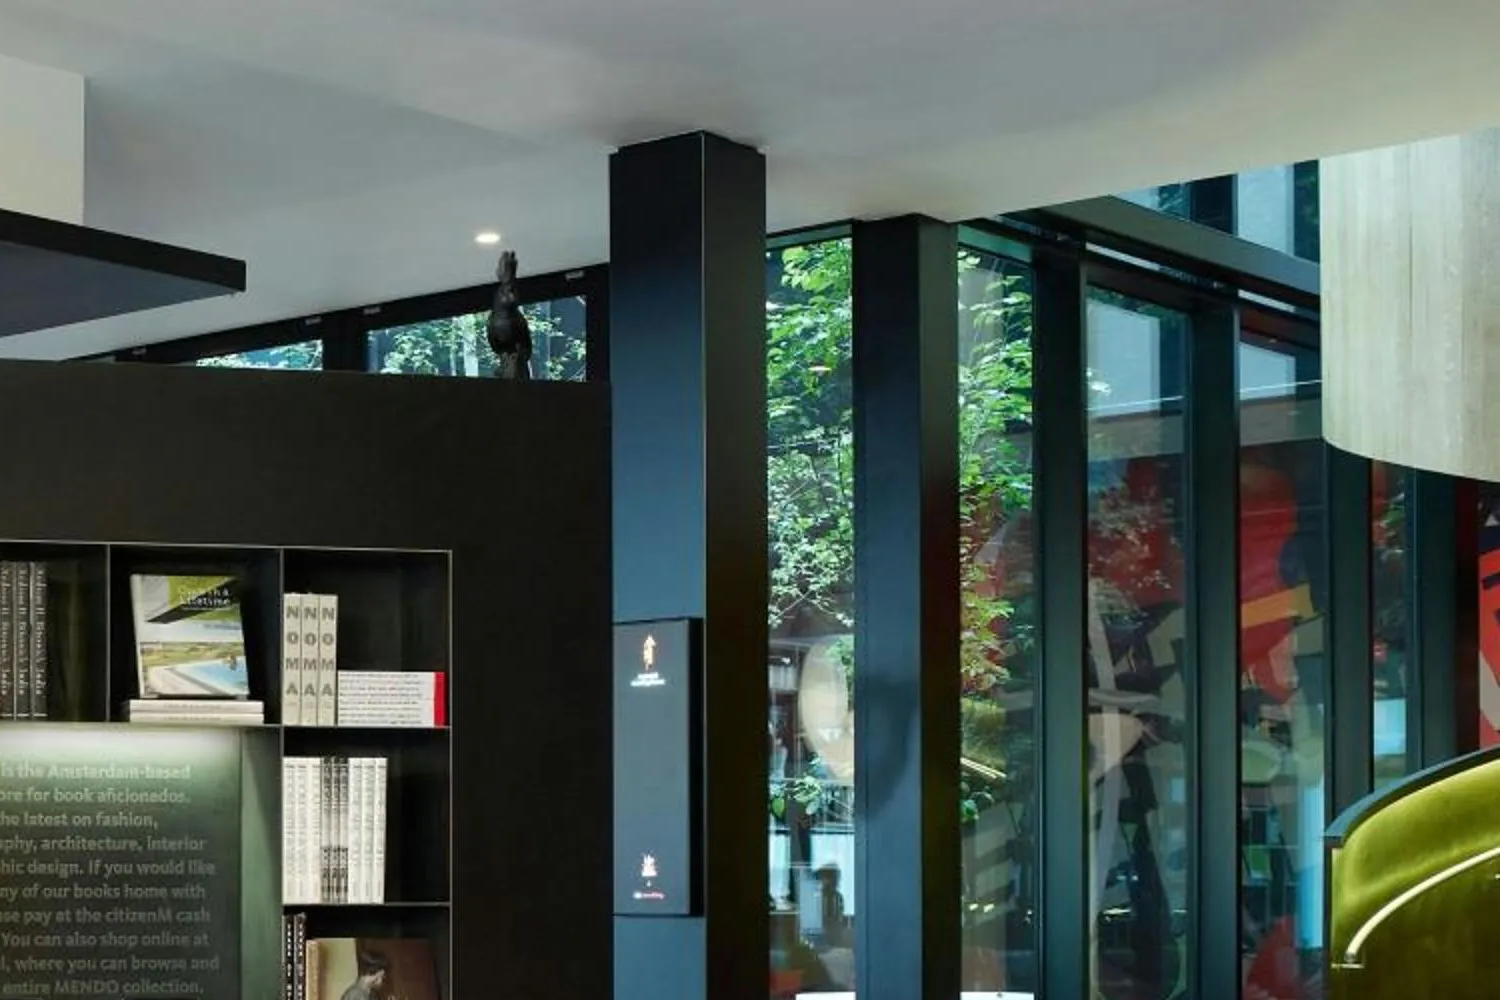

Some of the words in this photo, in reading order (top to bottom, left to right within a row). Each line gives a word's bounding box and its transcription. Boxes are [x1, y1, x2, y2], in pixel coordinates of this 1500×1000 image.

[304, 607, 317, 696] NOMA
[1, 762, 15, 778] is
[18, 761, 45, 778] the
[47, 764, 191, 779] Amsterdam-based
[26, 787, 51, 802] for
[53, 787, 96, 802] book
[24, 810, 69, 826] latest
[72, 814, 92, 827] on
[96, 810, 159, 830] fashion,
[147, 834, 207, 851] interior
[27, 858, 85, 879] design.
[89, 858, 101, 875] If
[104, 861, 133, 879] you
[136, 858, 185, 876] would
[187, 858, 217, 876] like
[22, 882, 40, 899] of
[43, 886, 71, 899] our
[73, 882, 121, 899] books
[123, 882, 168, 900] home
[171, 882, 206, 900] with
[23, 910, 52, 927] pay
[55, 908, 72, 924] at
[75, 905, 101, 924] the
[105, 905, 173, 924] citizenM
[175, 905, 212, 923] cash
[1, 931, 32, 947] You
[33, 934, 63, 947] can
[65, 930, 98, 947] also
[100, 930, 139, 951] shop
[141, 930, 190, 947] online
[193, 932, 210, 947] at
[14, 955, 65, 972] where
[67, 958, 97, 975] you
[100, 957, 128, 971] can
[131, 953, 187, 971] browse
[190, 953, 221, 971] and
[2, 978, 51, 995] entire
[53, 979, 119, 995] MENDO
[122, 978, 205, 996] collection.
